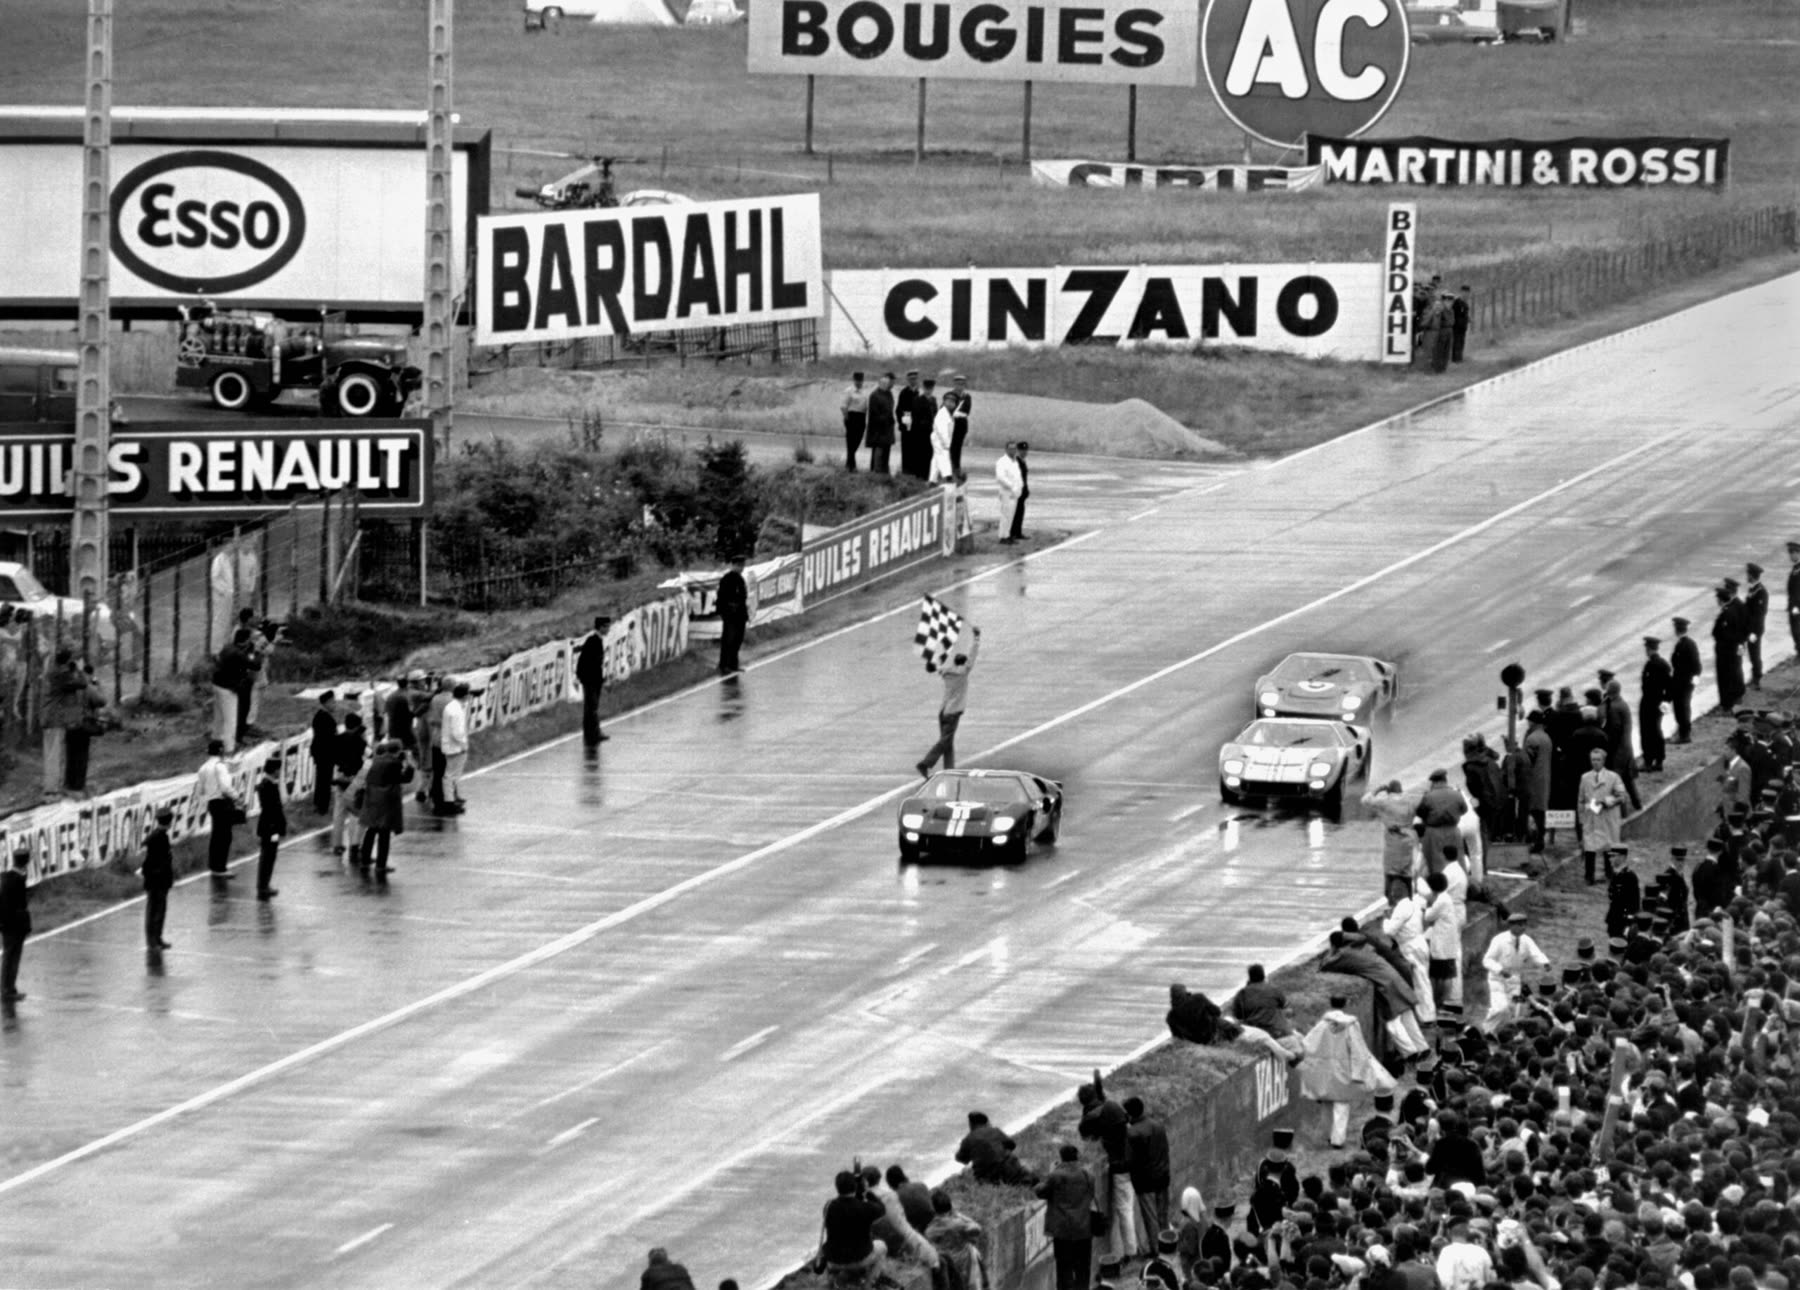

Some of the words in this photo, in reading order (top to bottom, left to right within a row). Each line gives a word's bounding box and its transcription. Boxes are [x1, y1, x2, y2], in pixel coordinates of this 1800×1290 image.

[781, 1, 1165, 68] BOUGIES
[1226, 0, 1387, 100] AC
[1321, 145, 1522, 186] MARTINI
[1532, 149, 1560, 186] &
[1570, 147, 1718, 186] ROSSI
[492, 206, 807, 334] BARDAHL
[883, 269, 1340, 346] CINZANO
[1386, 210, 1411, 355] BARDAHL
[0, 442, 140, 496] UILS
[168, 438, 410, 492] RENAULT
[803, 534, 862, 596] HUILES
[868, 503, 940, 569] RENAULT
